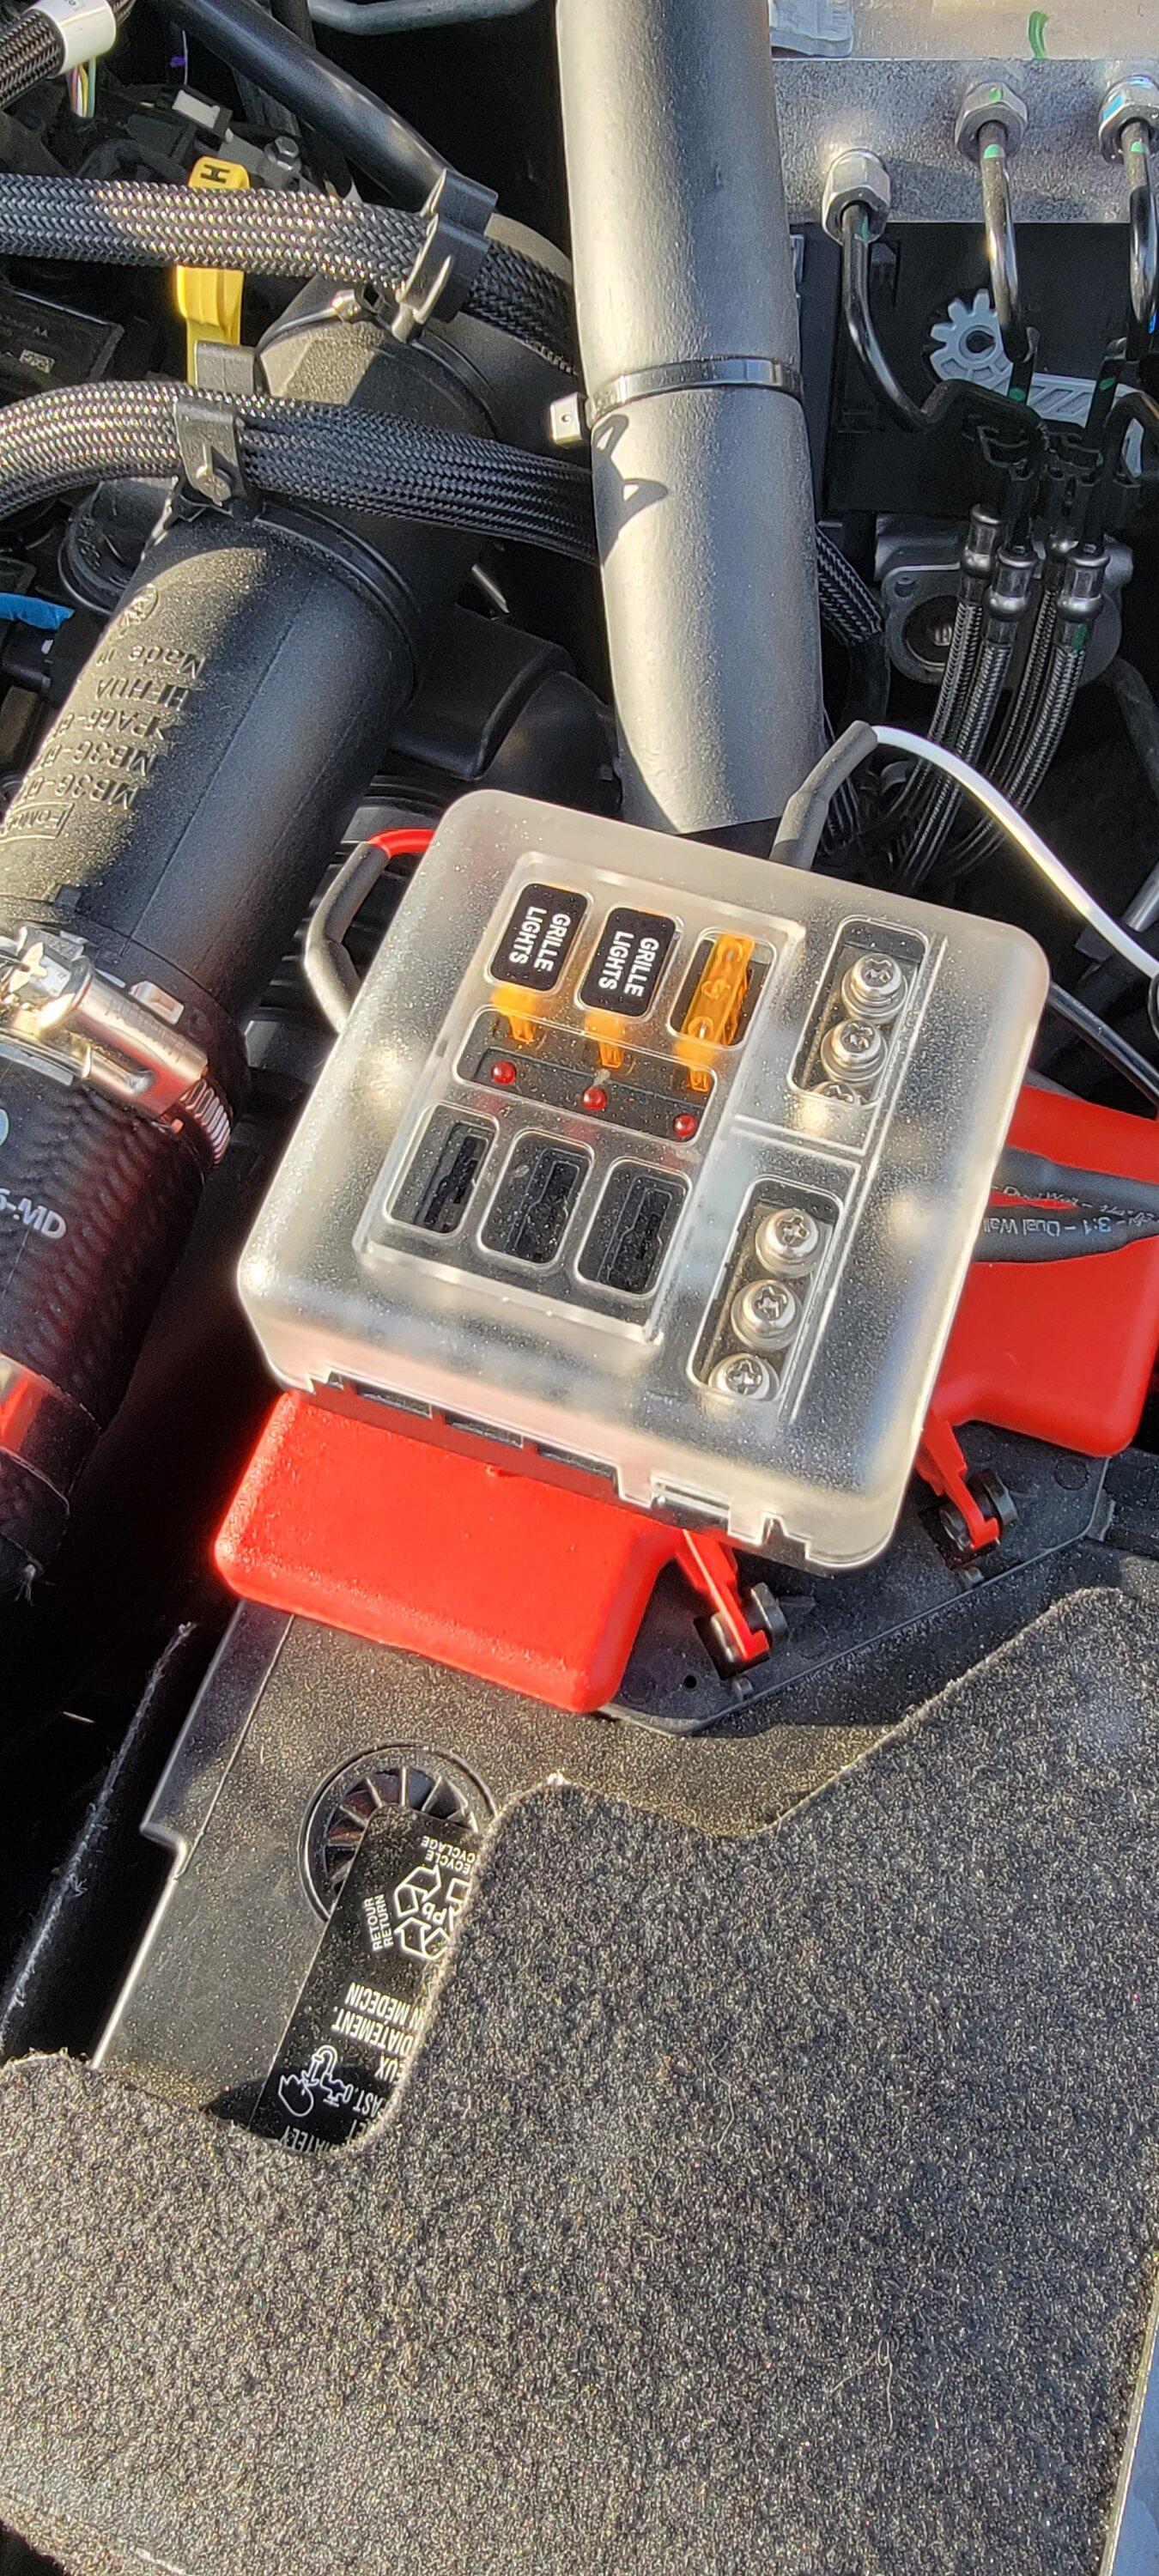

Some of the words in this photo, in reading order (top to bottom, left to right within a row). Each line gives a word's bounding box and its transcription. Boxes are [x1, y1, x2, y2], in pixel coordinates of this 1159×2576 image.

[129, 644, 206, 679] Made
[509, 905, 548, 965] LIGHTS
[534, 912, 572, 972] GRILLE
[598, 930, 635, 990] LIGHTS
[624, 936, 659, 998] GRILLE
[982, 1216, 1019, 1236] Wall
[1022, 1218, 1061, 1237] Dual
[1083, 1216, 1112, 1236] 3:1
[421, 1835, 476, 1864] CYCLAGE
[424, 1849, 471, 1875] ECYCLE
[363, 1896, 383, 1952] RETOUR
[373, 1893, 394, 1948] RETURN
[422, 1901, 447, 1925] Pb
[344, 1982, 411, 2026] MÉDECIN
[331, 2006, 414, 2058] DIATEMENT.
